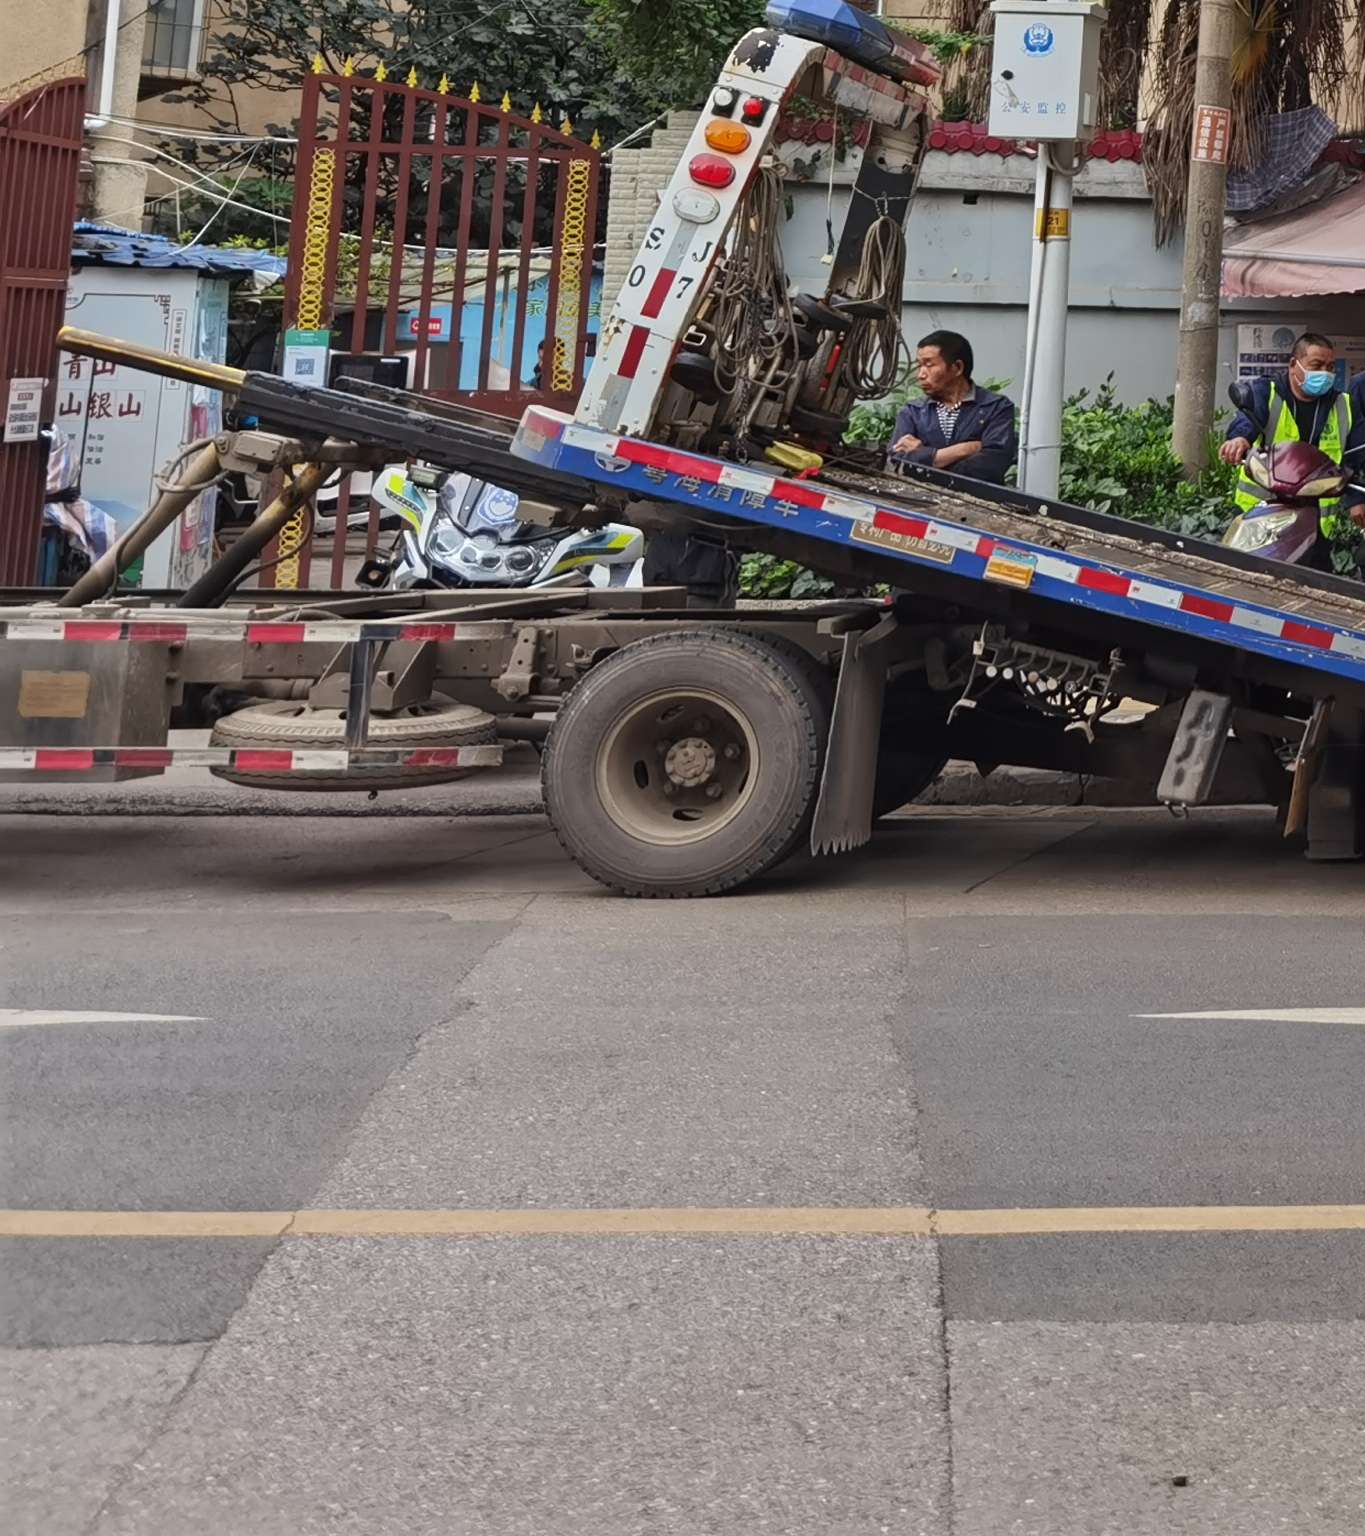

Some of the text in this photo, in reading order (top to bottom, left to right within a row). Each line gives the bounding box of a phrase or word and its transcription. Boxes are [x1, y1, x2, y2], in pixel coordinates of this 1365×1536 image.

[1000, 100, 1067, 114] 公安监控
[59, 392, 141, 419] 山银山
